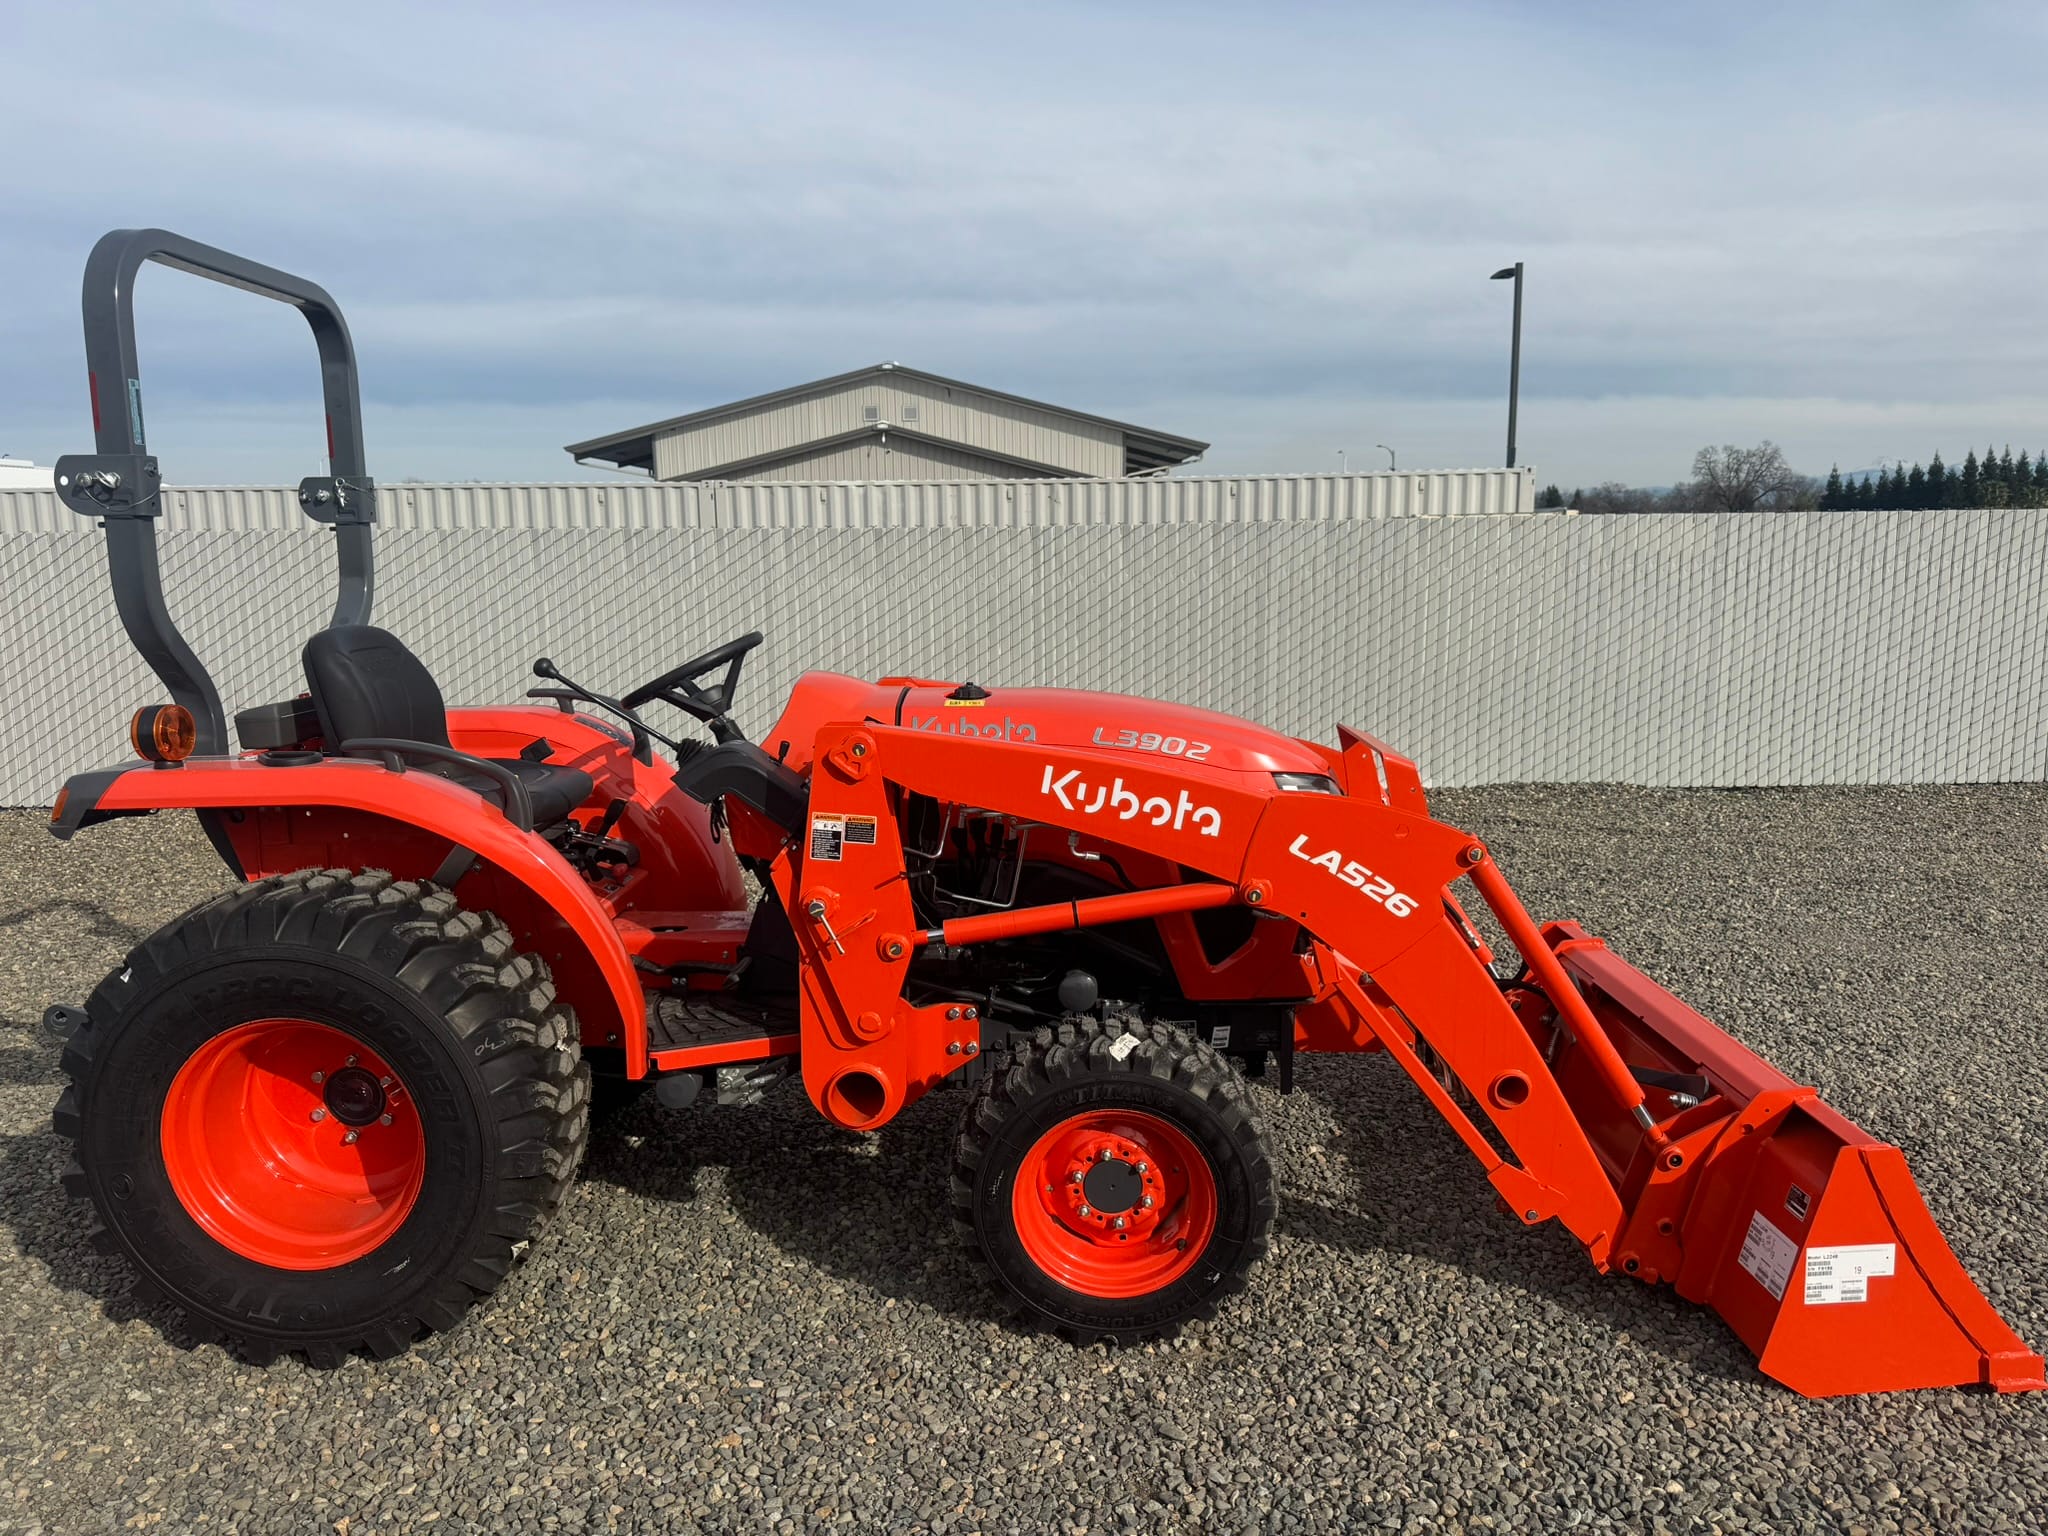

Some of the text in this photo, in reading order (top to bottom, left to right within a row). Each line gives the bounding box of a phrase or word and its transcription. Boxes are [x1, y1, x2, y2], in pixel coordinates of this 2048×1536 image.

[912, 715, 1037, 742] Kubota
[1092, 726, 1212, 760] L3902
[1041, 765, 1222, 837] Kubota
[1288, 833, 1419, 918] LA526
